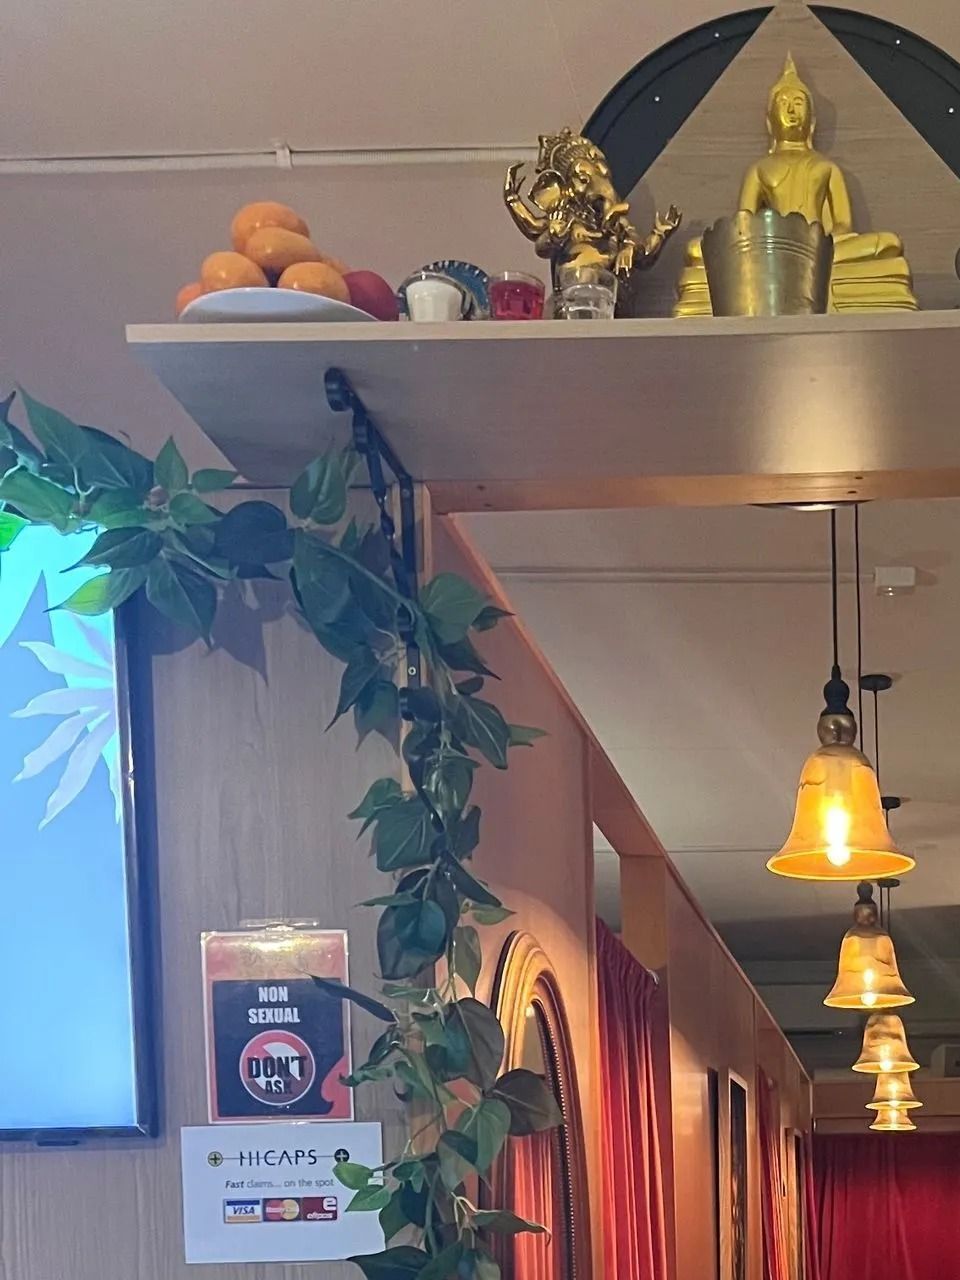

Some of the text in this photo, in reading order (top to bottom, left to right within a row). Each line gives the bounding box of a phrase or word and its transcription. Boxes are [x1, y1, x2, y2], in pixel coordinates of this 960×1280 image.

[258, 987, 288, 1002] NON
[248, 1008, 300, 1024] SEXUAL
[247, 1056, 306, 1078] DON'T
[265, 1079, 293, 1094] ASK
[240, 1149, 317, 1166] HICAPS
[225, 1180, 244, 1189] Fast
[284, 1180, 295, 1188] on
[298, 1178, 313, 1187] the
[315, 1178, 334, 1189] spot
[232, 1206, 255, 1215] VISA
